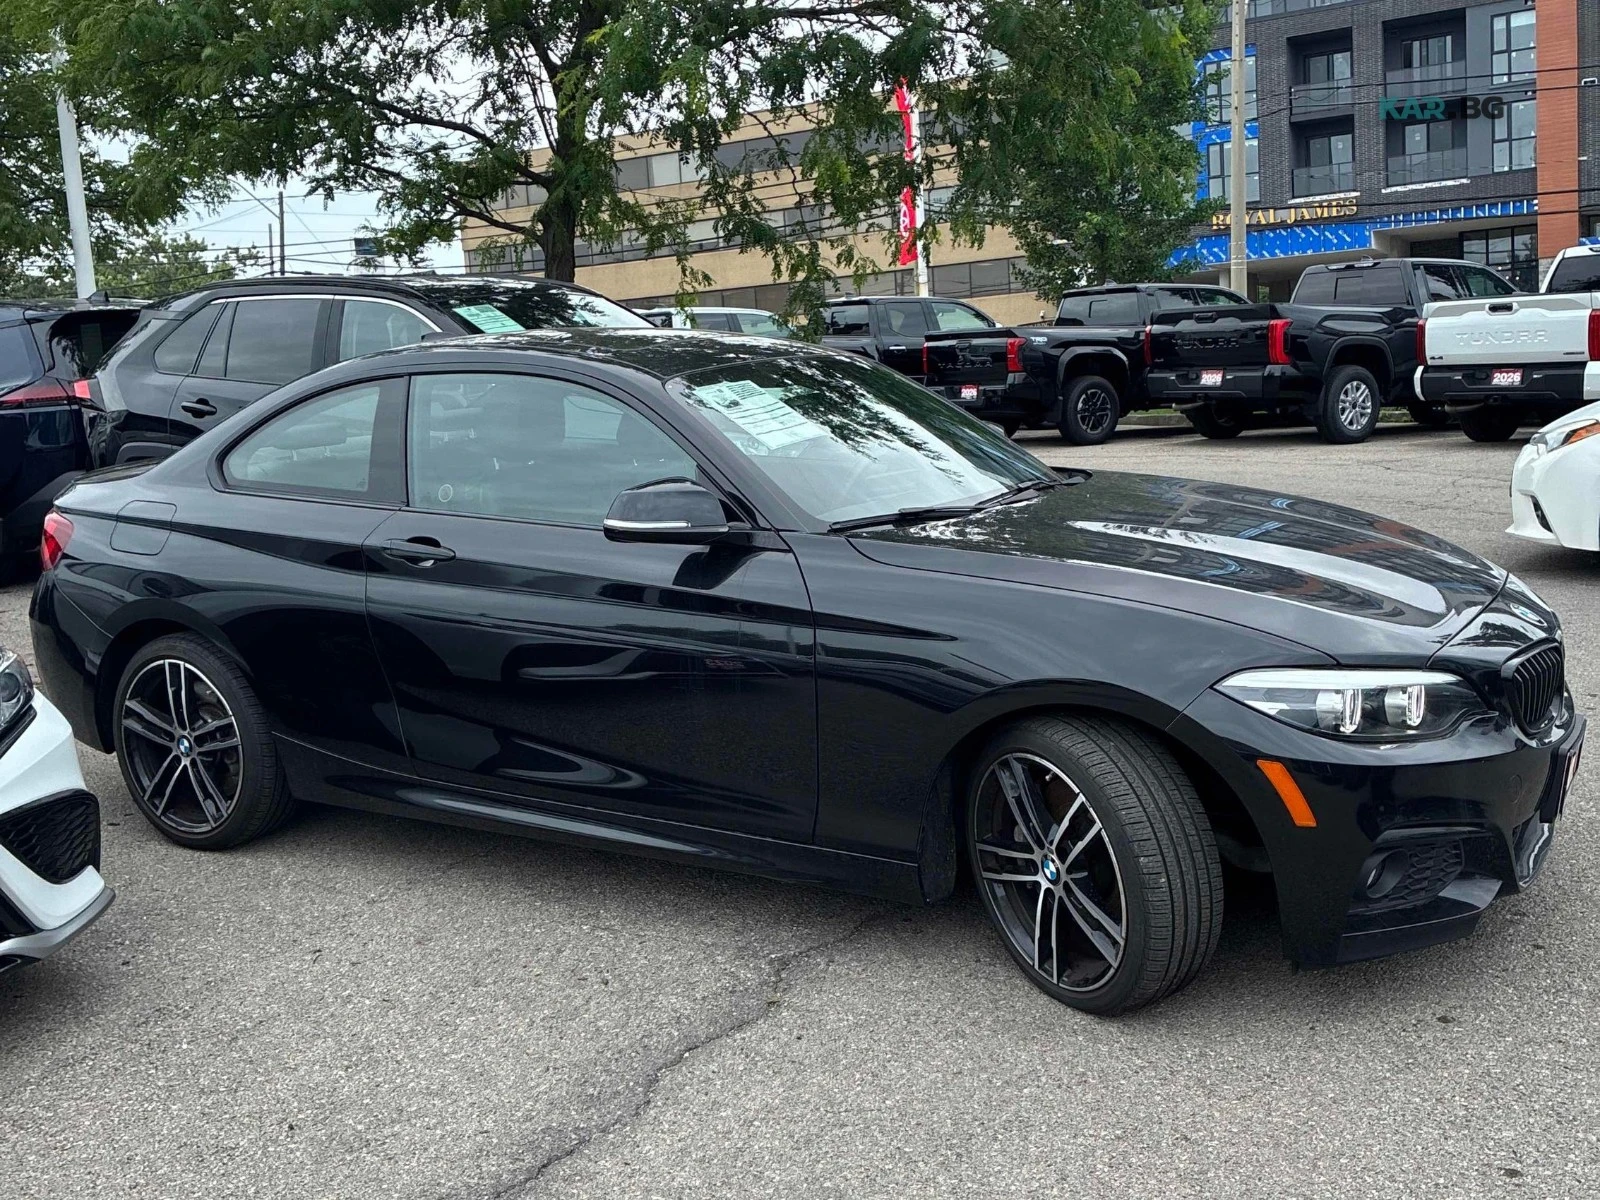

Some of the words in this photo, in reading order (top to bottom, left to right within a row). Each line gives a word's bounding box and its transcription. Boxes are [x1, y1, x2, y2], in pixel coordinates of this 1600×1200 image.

[1286, 198, 1358, 224] JAMES
[1455, 329, 1549, 345] TUNDRA
[1171, 338, 1240, 349] TUNDRA
[937, 361, 993, 369] TACOMA
[1201, 373, 1222, 382] 2026
[1492, 372, 1521, 383] 2026
